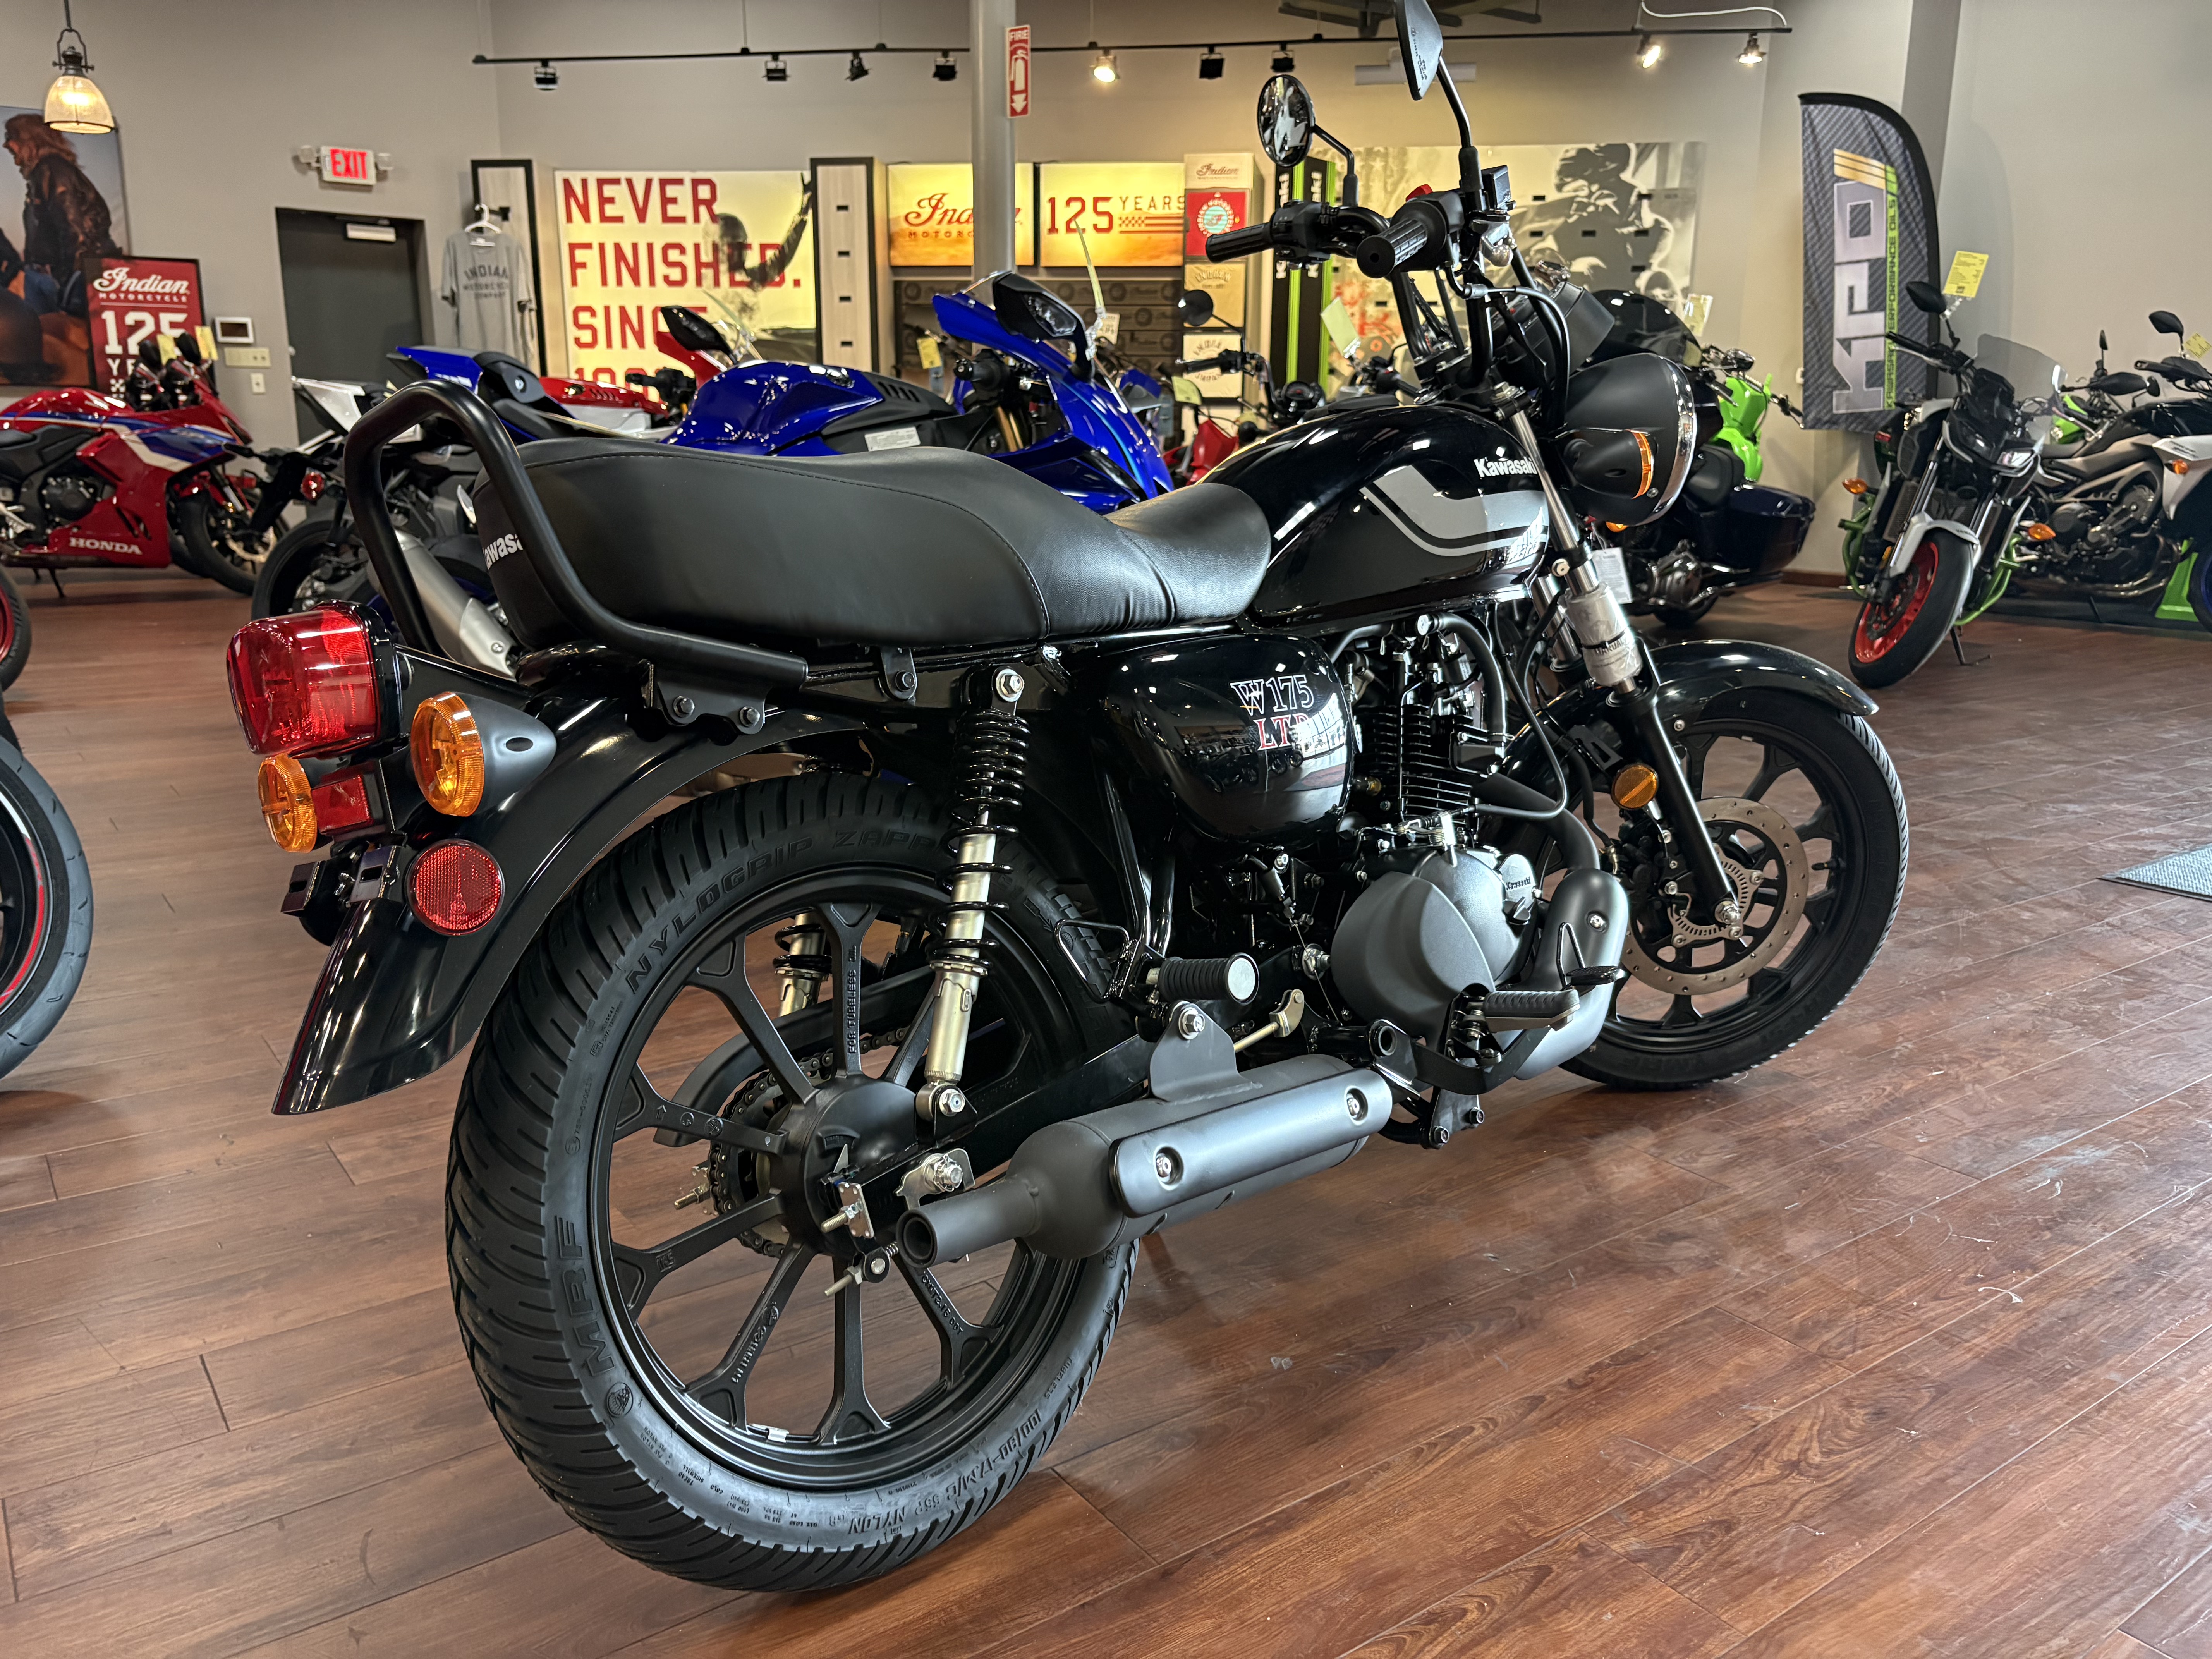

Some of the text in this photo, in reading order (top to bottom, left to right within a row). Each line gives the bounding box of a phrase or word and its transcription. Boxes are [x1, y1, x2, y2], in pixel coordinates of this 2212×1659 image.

[330, 148, 368, 180] EXIT
[1196, 163, 1239, 176] Indian
[563, 178, 719, 224] NEVER
[1047, 196, 1185, 235] 125 YEARS
[93, 267, 189, 294] Indian
[1887, 235, 1897, 330] ERFORMANCE
[99, 293, 187, 303] MOTORCYCLE
[573, 306, 707, 349] SIN
[1474, 457, 1537, 478] Kawasaki
[70, 538, 142, 555] HONDA
[626, 830, 940, 994] NYLOGRIP ZAPP
[846, 970, 857, 1054] FOR TUBELESS
[555, 1215, 615, 1377] MRF
[949, 1317, 963, 1335] DOT
[1045, 1357, 1074, 1398] TUBELESS
[640, 1433, 653, 1450] NYLON
[644, 1427, 658, 1444] NYLON
[678, 1472, 694, 1486] TREAD
[683, 1464, 704, 1483] SIDEWALL
[710, 1484, 723, 1494] COLD
[848, 1506, 905, 1534] NYLON
